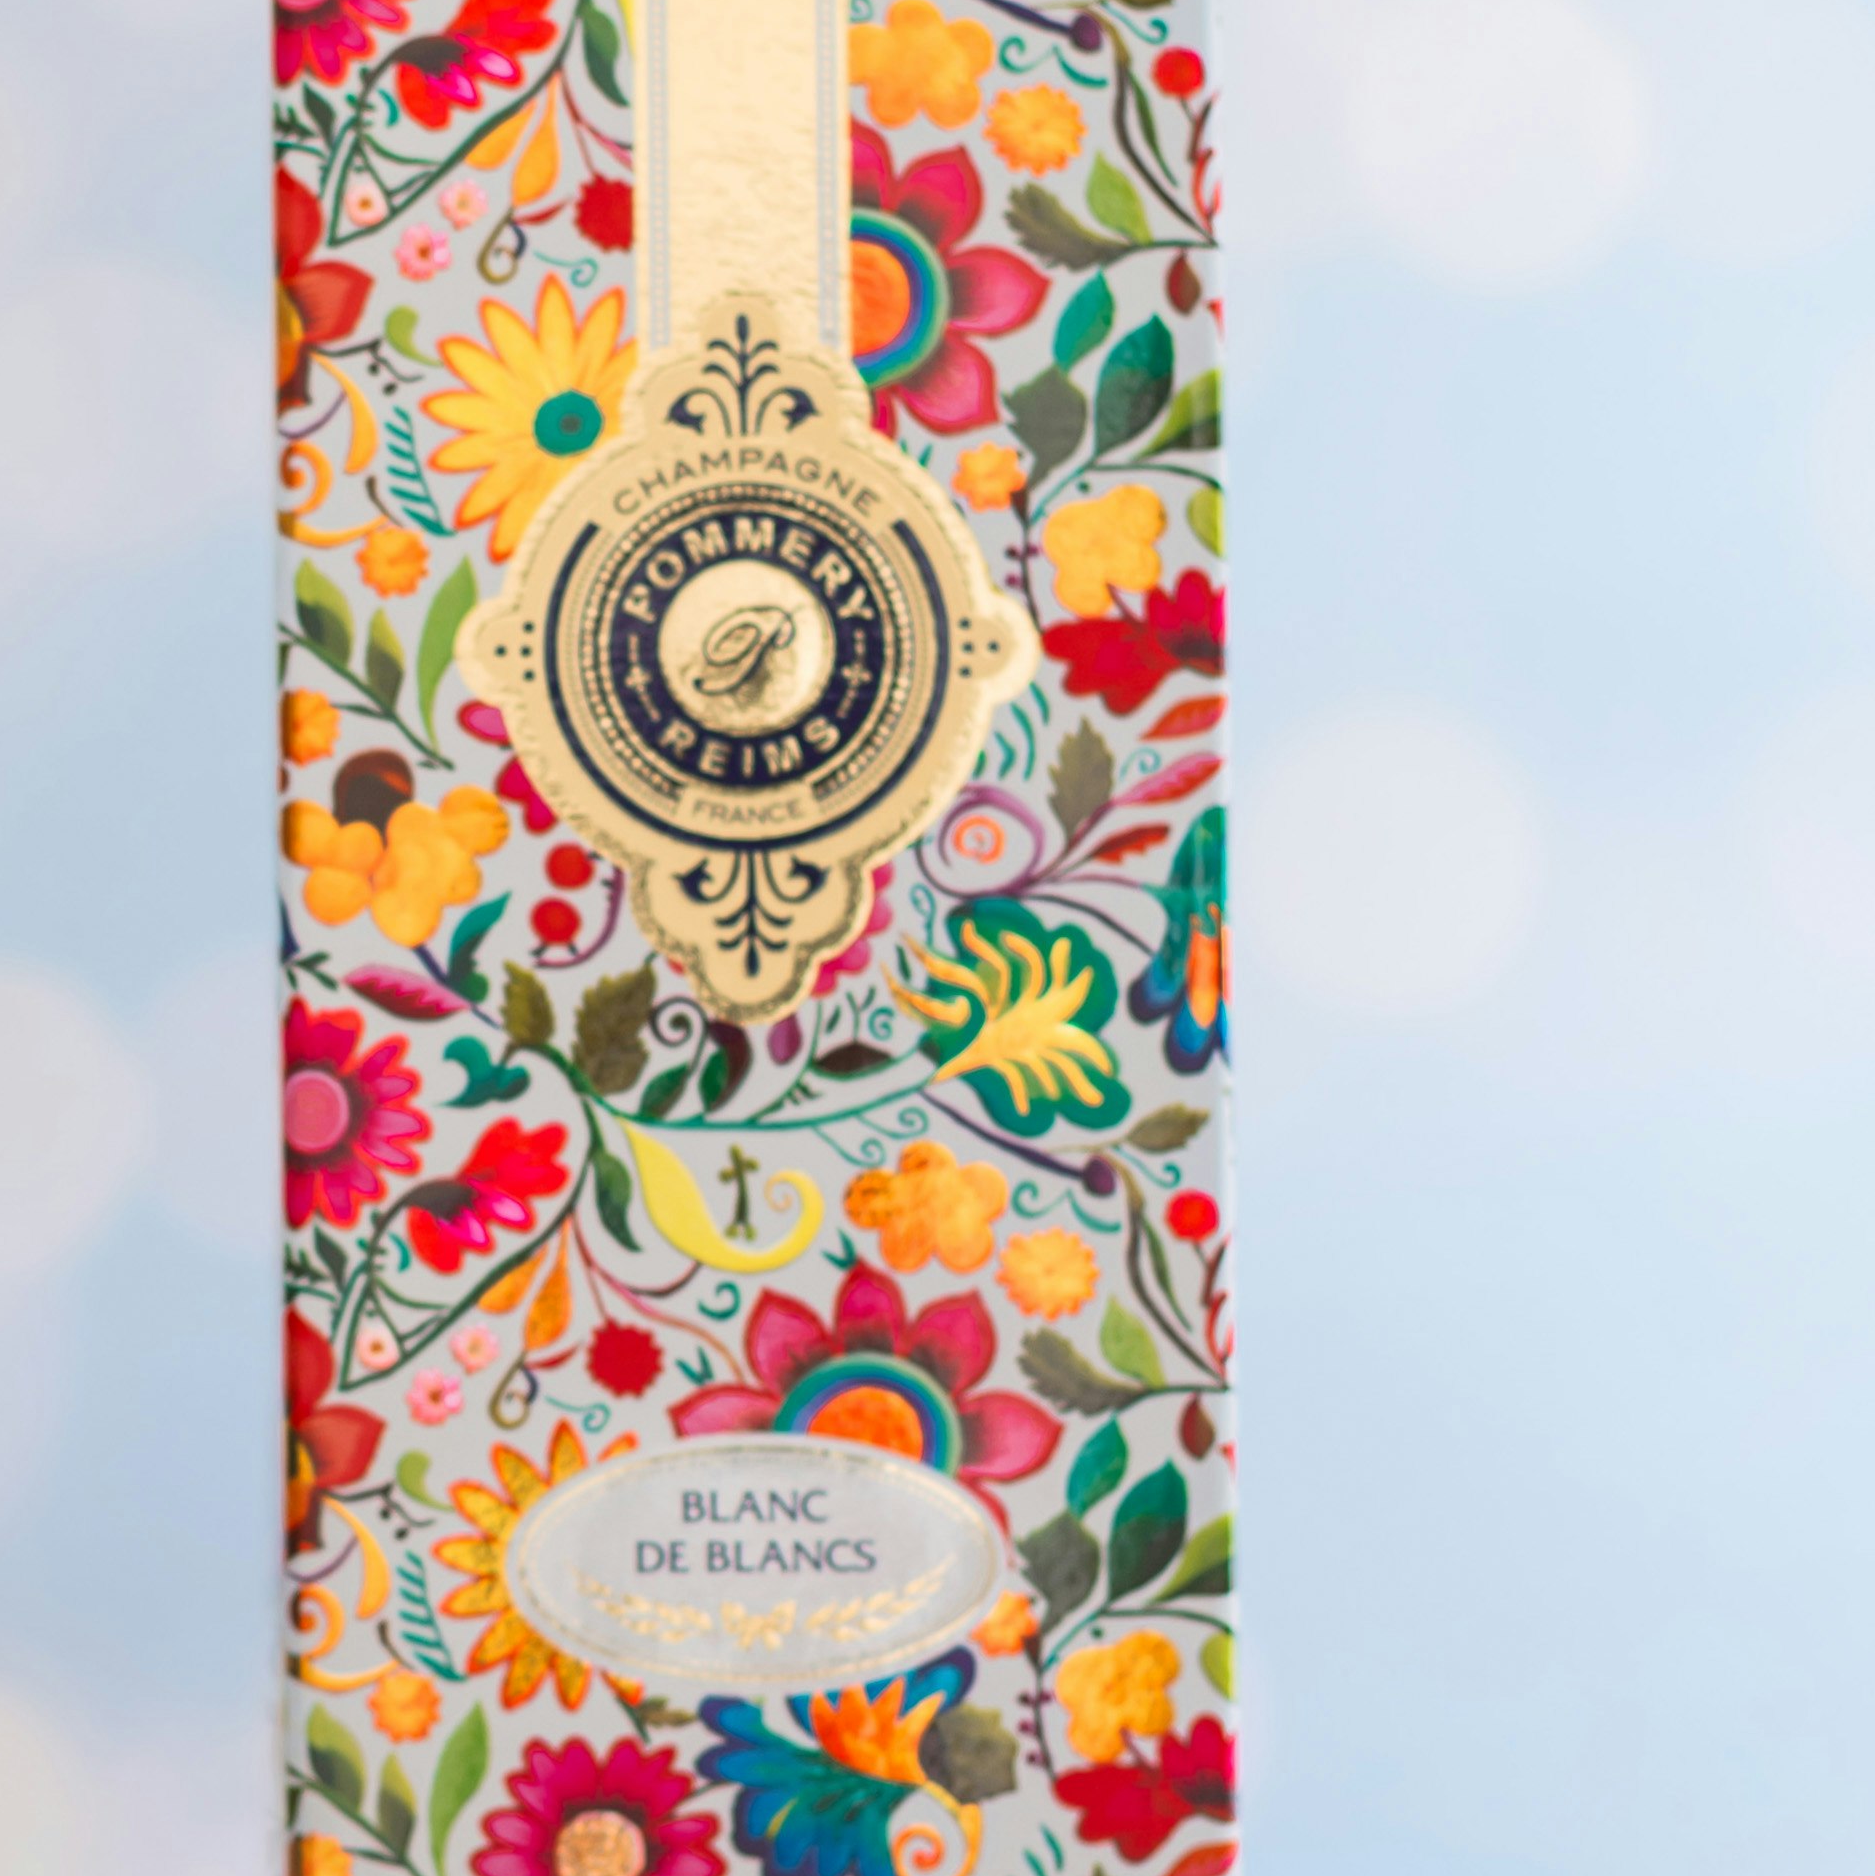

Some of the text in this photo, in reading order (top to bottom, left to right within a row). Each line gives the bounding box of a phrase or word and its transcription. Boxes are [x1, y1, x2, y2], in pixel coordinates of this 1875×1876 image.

[612, 447, 881, 517] CHAMPAGNE
[624, 517, 875, 625] POMMERY
[660, 722, 840, 780] REIMS
[692, 797, 806, 827] FRANCE
[680, 1489, 828, 1524] BLANC
[635, 1538, 878, 1574] DE BLANCS
